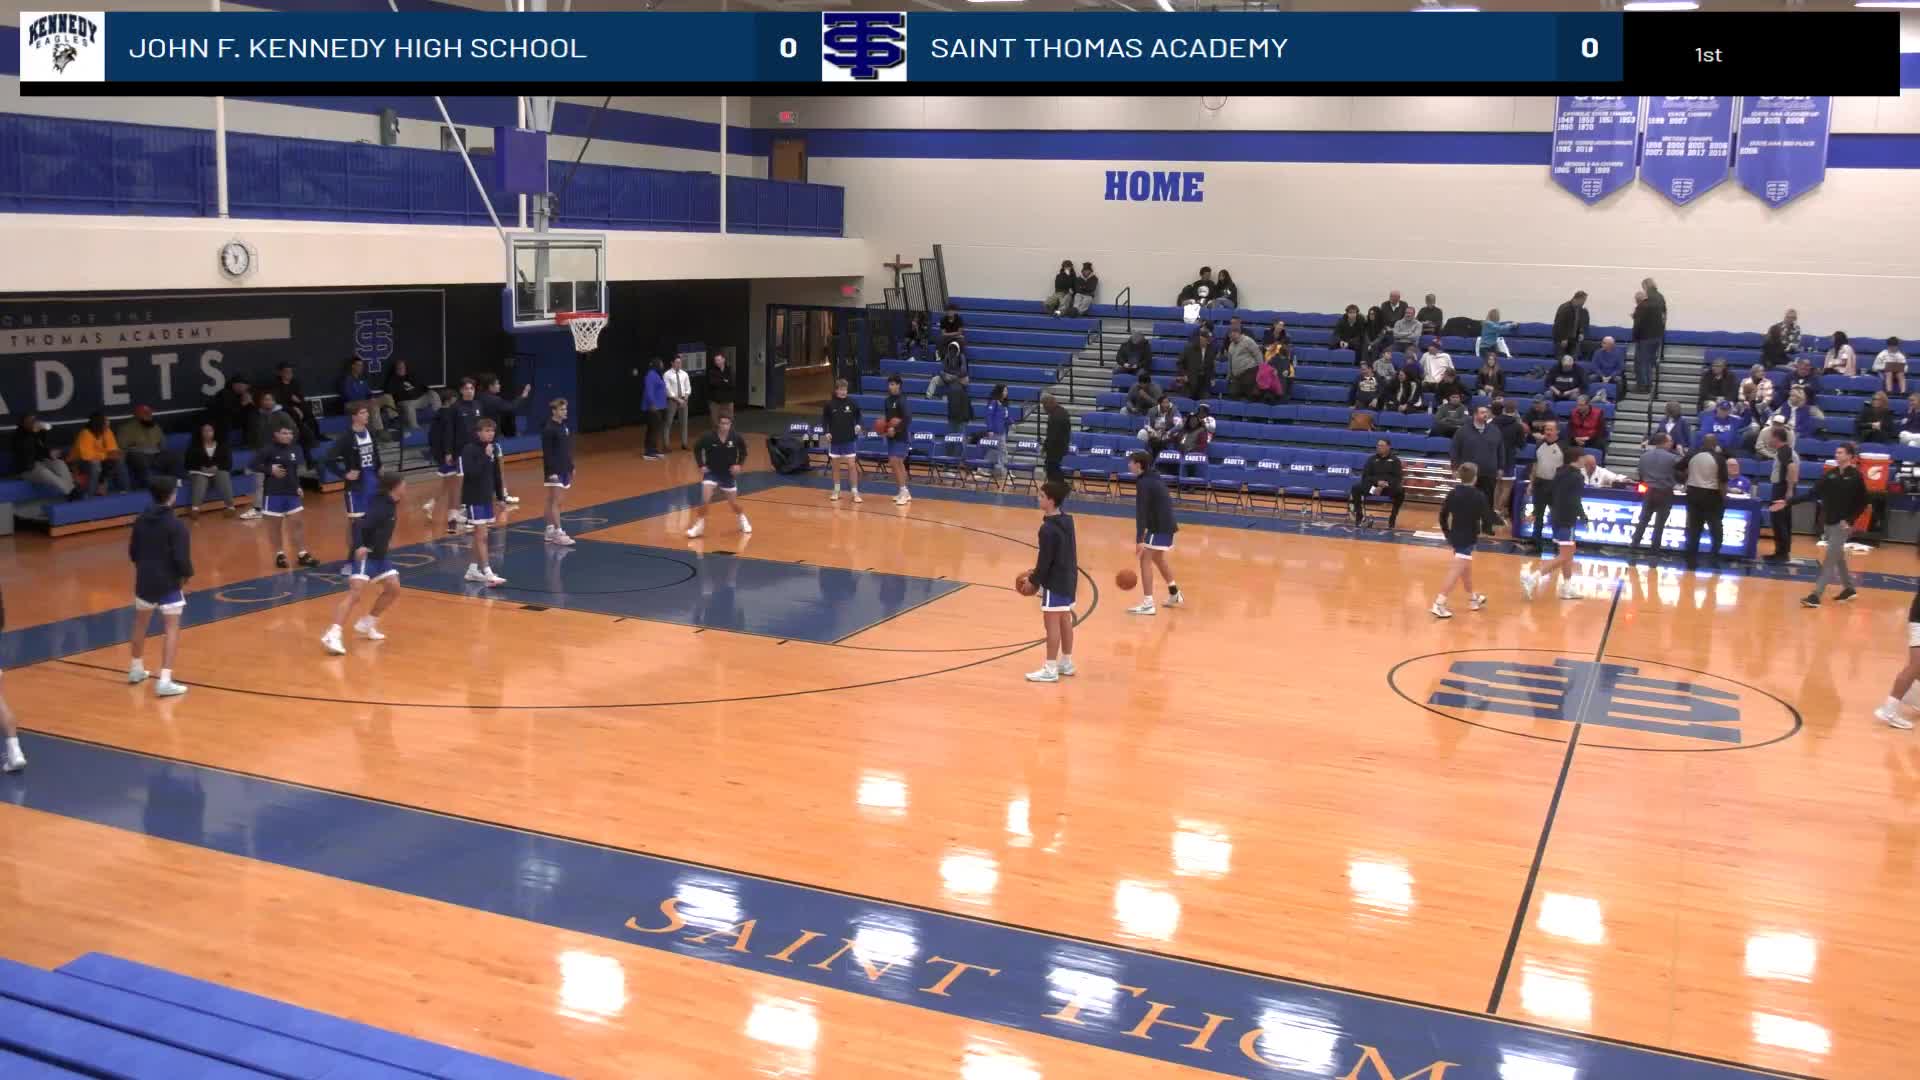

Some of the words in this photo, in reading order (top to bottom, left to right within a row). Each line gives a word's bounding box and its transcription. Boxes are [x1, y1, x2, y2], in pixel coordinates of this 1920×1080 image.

[1104, 170, 1205, 202] HOME
[11, 332, 103, 347] THOMAS
[119, 327, 213, 343] ACADEMY
[979, 438, 998, 446] CADETS
[1091, 447, 1111, 455] CADETS
[1159, 452, 1181, 460] CADETS
[1184, 454, 1207, 462] CADETS
[1223, 457, 1245, 465] CADETS
[1258, 461, 1280, 470] CADETS
[1290, 464, 1313, 472] CADETS
[1327, 466, 1350, 474] CADETS
[624, 897, 1001, 997] SAINT
